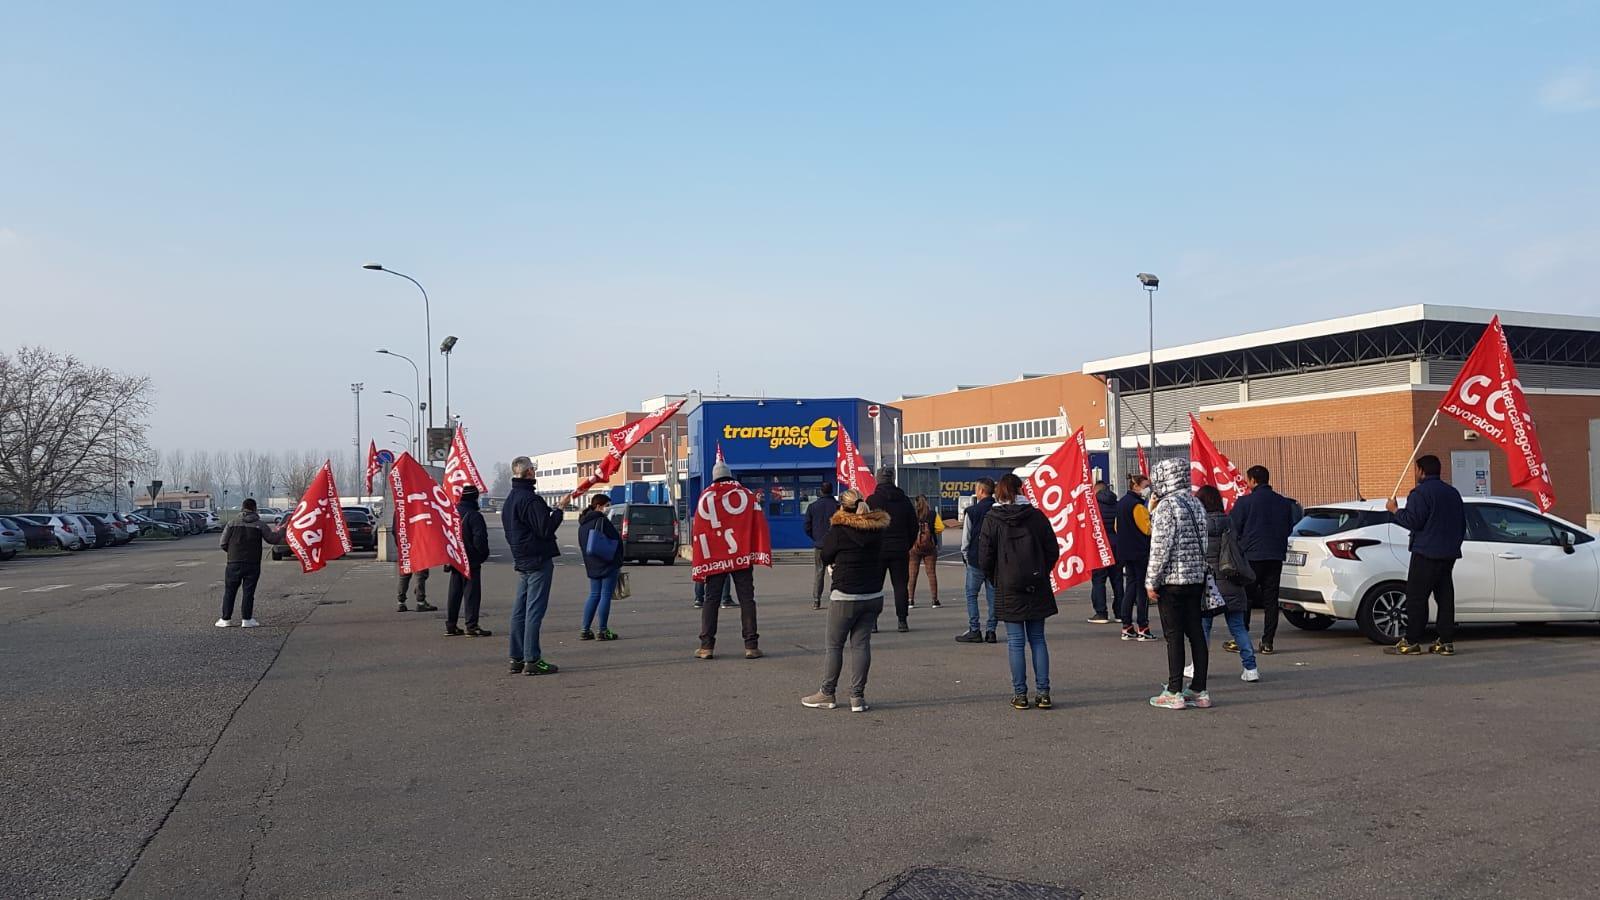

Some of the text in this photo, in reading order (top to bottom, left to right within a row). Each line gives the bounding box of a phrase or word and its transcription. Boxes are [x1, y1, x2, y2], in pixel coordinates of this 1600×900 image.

[723, 424, 809, 439] transmec
[1501, 380, 1540, 477] Intercategoriale
[769, 437, 809, 449] group
[1083, 483, 1111, 567] Intercategoriale
[692, 560, 734, 576] Intercat
